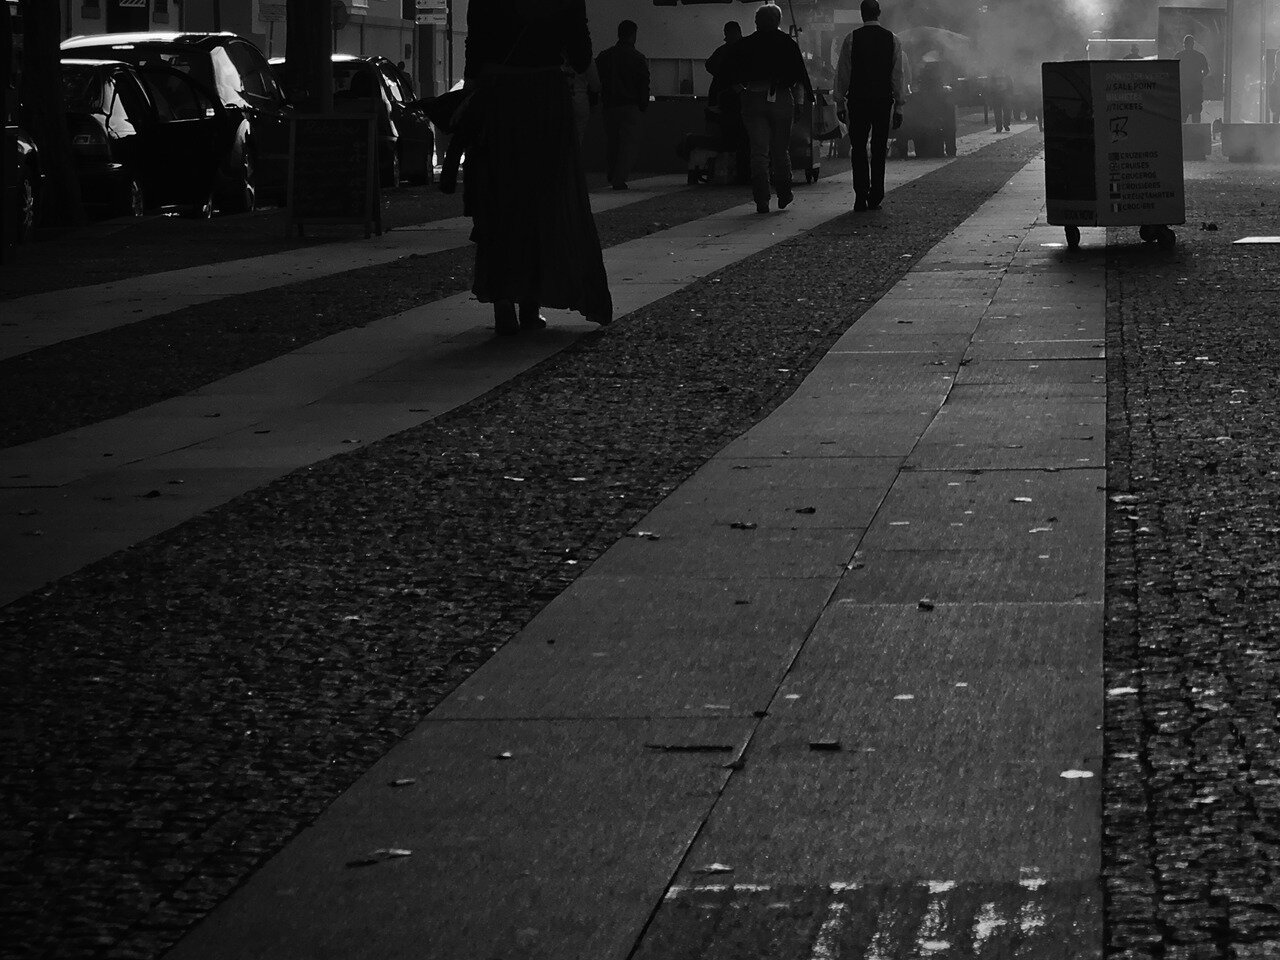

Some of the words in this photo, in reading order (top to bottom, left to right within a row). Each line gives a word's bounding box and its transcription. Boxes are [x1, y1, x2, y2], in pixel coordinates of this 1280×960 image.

[1133, 82, 1157, 91] POINT
[1120, 151, 1158, 159] CRUZEIROS
[1121, 161, 1150, 169] CRUISES
[1121, 171, 1157, 180] CRUCEROS
